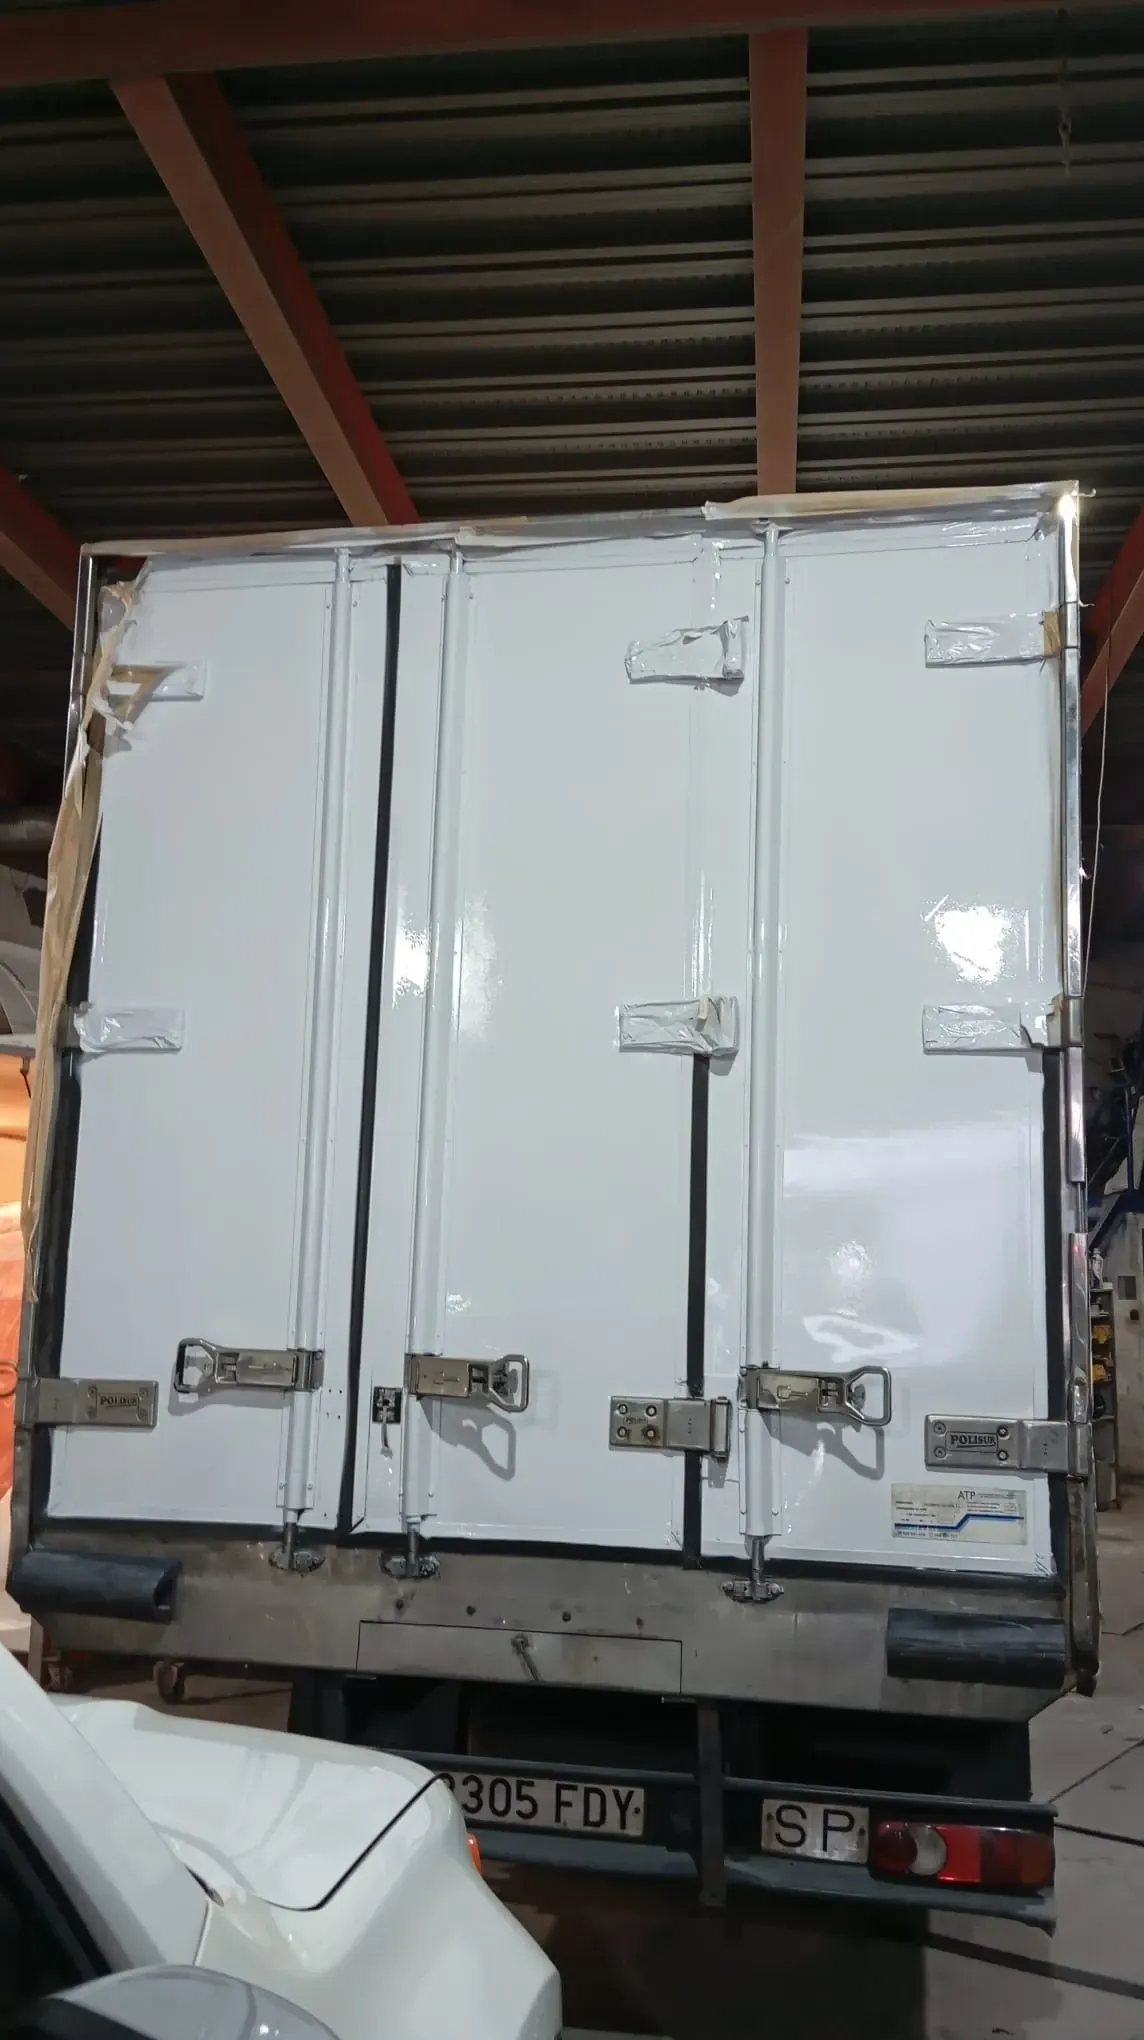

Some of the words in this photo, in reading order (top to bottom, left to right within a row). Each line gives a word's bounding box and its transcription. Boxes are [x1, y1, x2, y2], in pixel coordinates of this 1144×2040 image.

[950, 1434, 997, 1447] POLISUR
[957, 1490, 976, 1501] ATP
[554, 1782, 636, 1831] FDY
